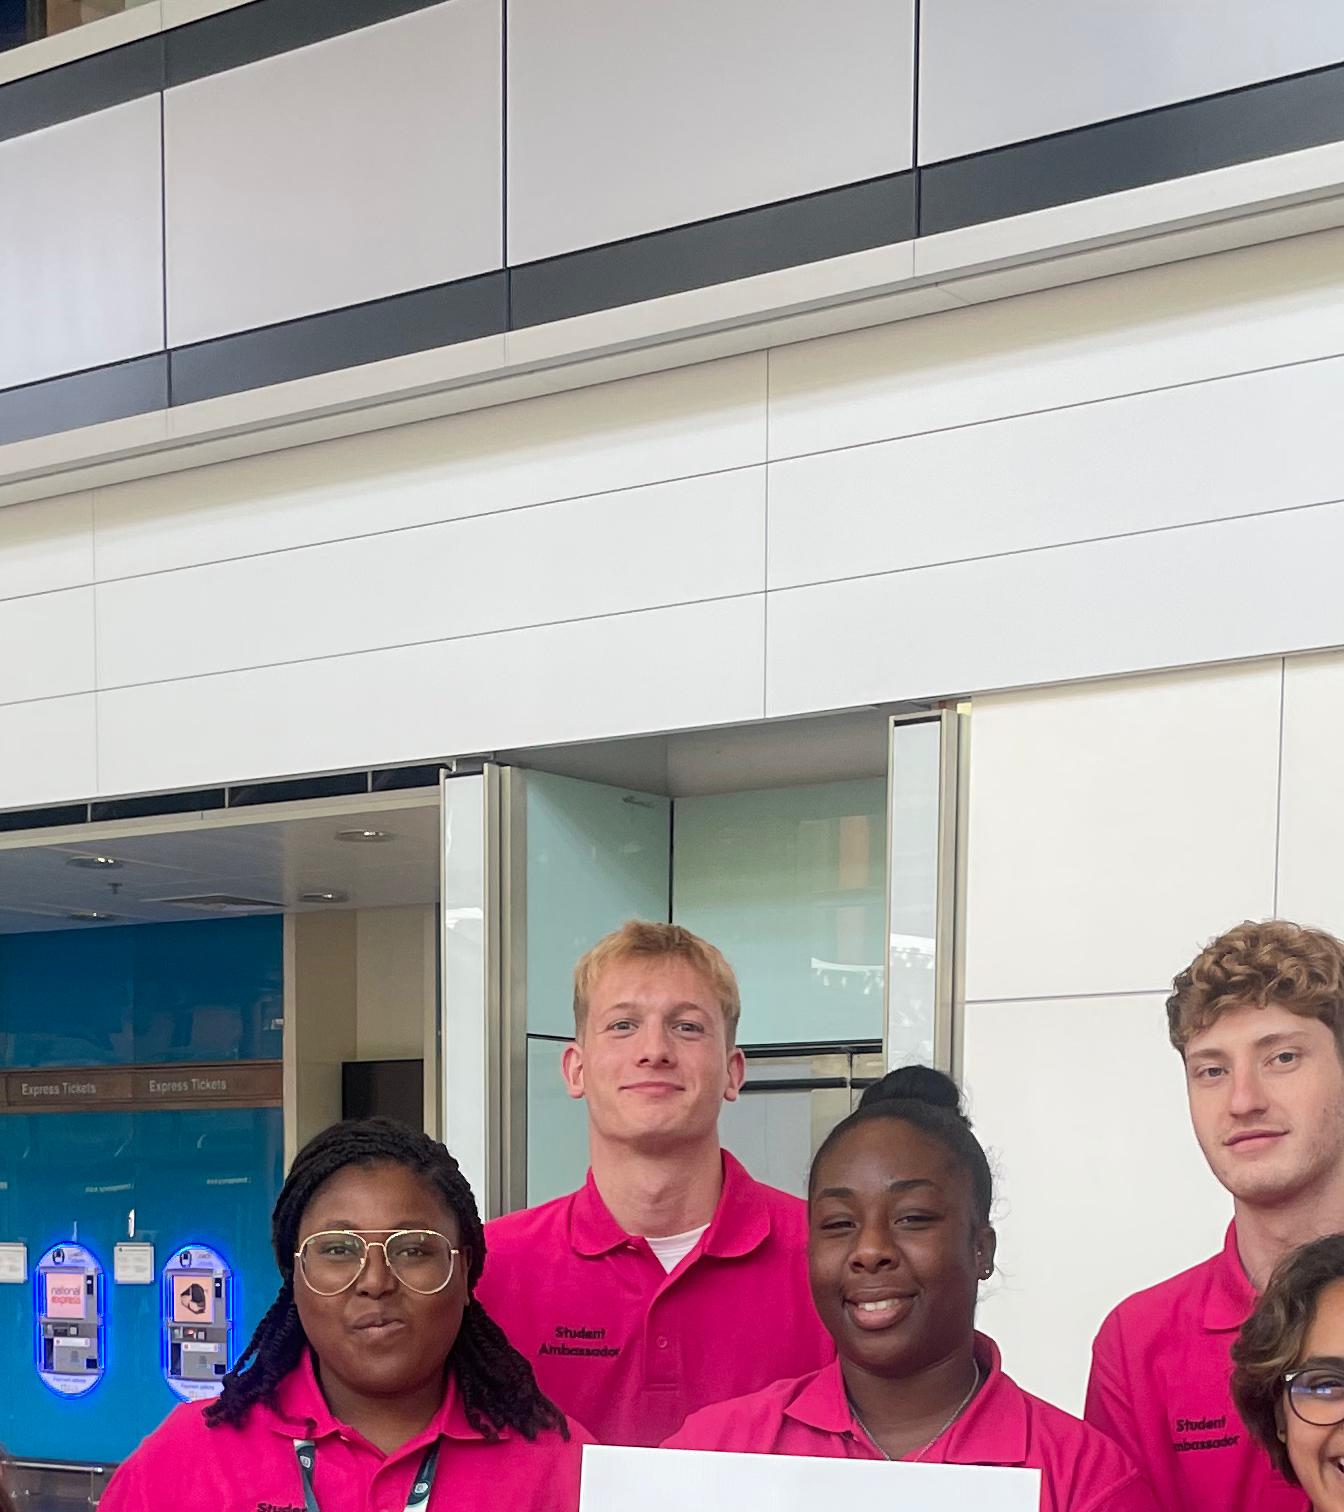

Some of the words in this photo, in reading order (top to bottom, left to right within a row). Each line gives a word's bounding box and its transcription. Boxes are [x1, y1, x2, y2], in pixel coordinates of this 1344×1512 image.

[21, 1083, 60, 1097] Express
[62, 1082, 97, 1095] Tickets
[149, 1080, 188, 1096] Express
[191, 1078, 226, 1090] Tickets
[556, 1326, 605, 1339] Student
[1176, 1416, 1227, 1432] Student
